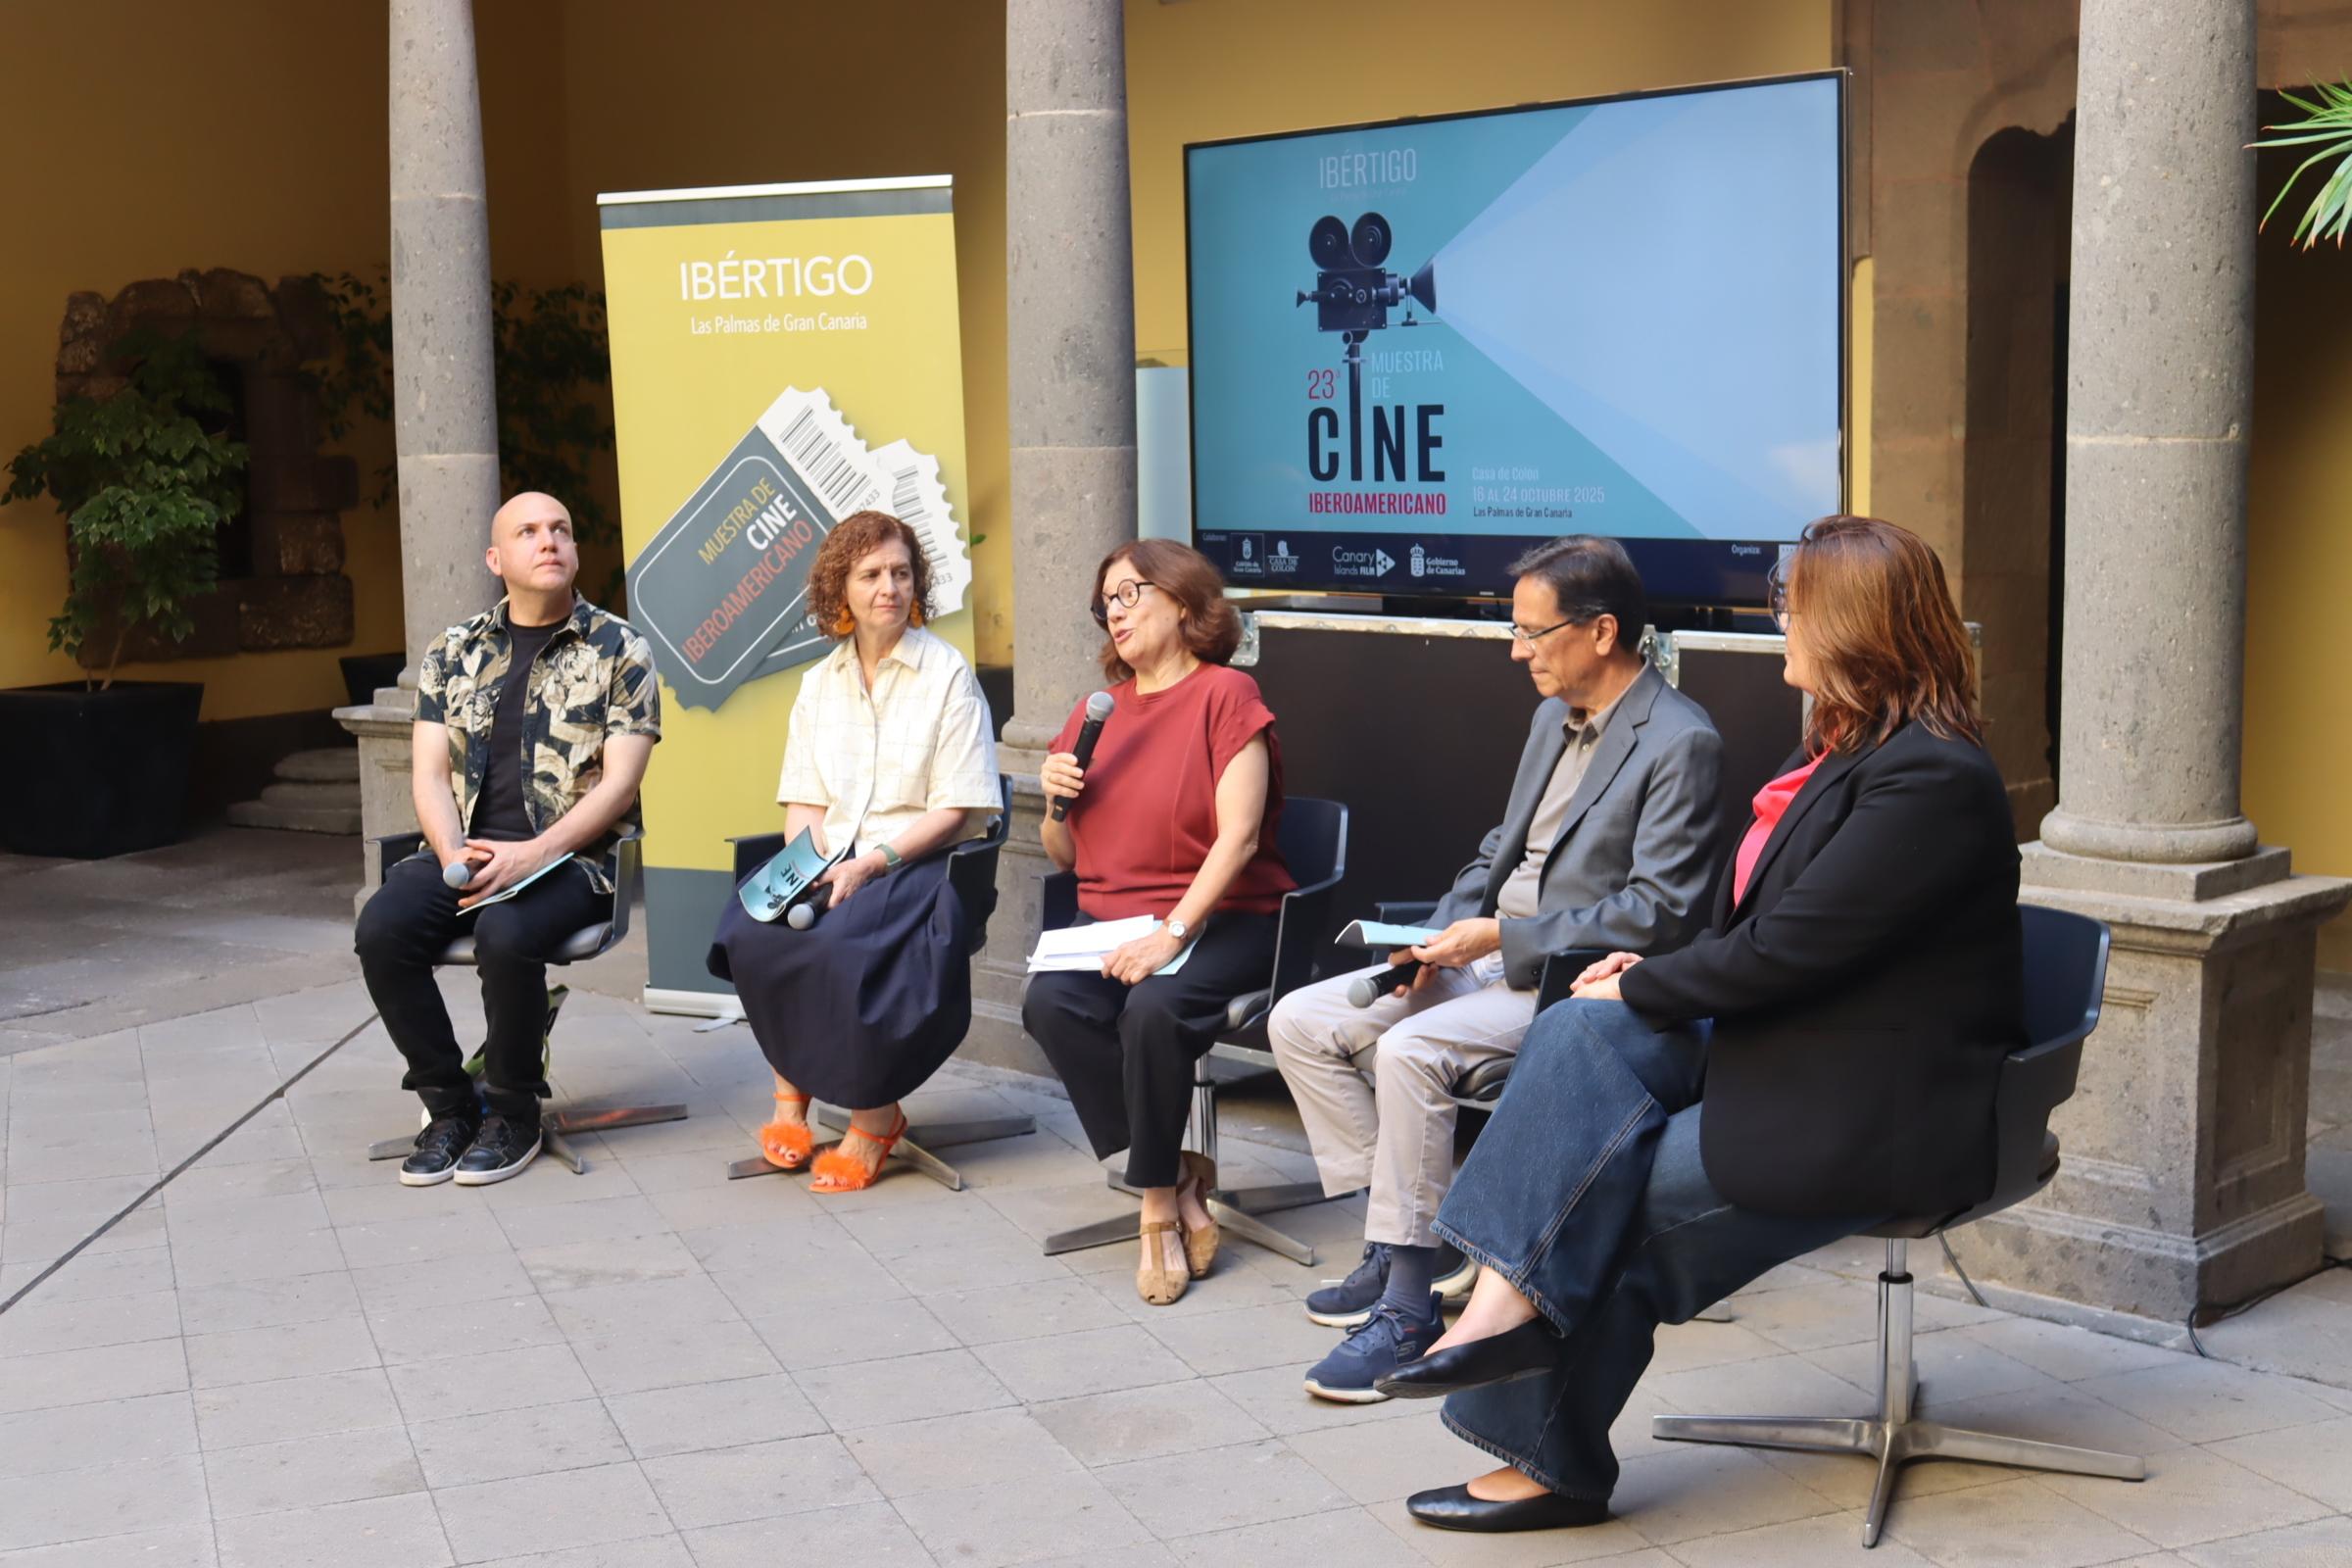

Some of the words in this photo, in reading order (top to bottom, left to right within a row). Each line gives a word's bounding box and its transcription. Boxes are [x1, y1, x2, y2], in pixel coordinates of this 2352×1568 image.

[1319, 148, 1416, 189] IBÉRTIGO
[680, 250, 873, 301] IBÉRTIGO
[691, 316, 711, 334] Las
[715, 315, 760, 333] Palmas
[764, 314, 780, 331] de
[784, 314, 814, 331] Gran
[818, 312, 867, 330] Canaria
[1372, 350, 1444, 373] MUESTRA
[1372, 376, 1391, 398] DE
[1307, 404, 1446, 483] CINE
[1308, 492, 1446, 515] IBEROAMERICANO
[1503, 486, 1518, 503] 24
[1520, 487, 1571, 503] OCTUBRE
[1574, 486, 1605, 503] 2025
[697, 501, 758, 565] MUESTRA
[751, 477, 776, 507] DE
[746, 493, 798, 551] CINE
[1473, 507, 1486, 517] Las
[1488, 507, 1513, 517] Palmas
[1515, 507, 1525, 517] de
[1526, 507, 1543, 517] Gran
[1544, 507, 1572, 518] Canaria
[1332, 546, 1375, 565] Canary
[1426, 557, 1458, 566] Gobierno
[681, 520, 813, 664] IBEROAMERICANO
